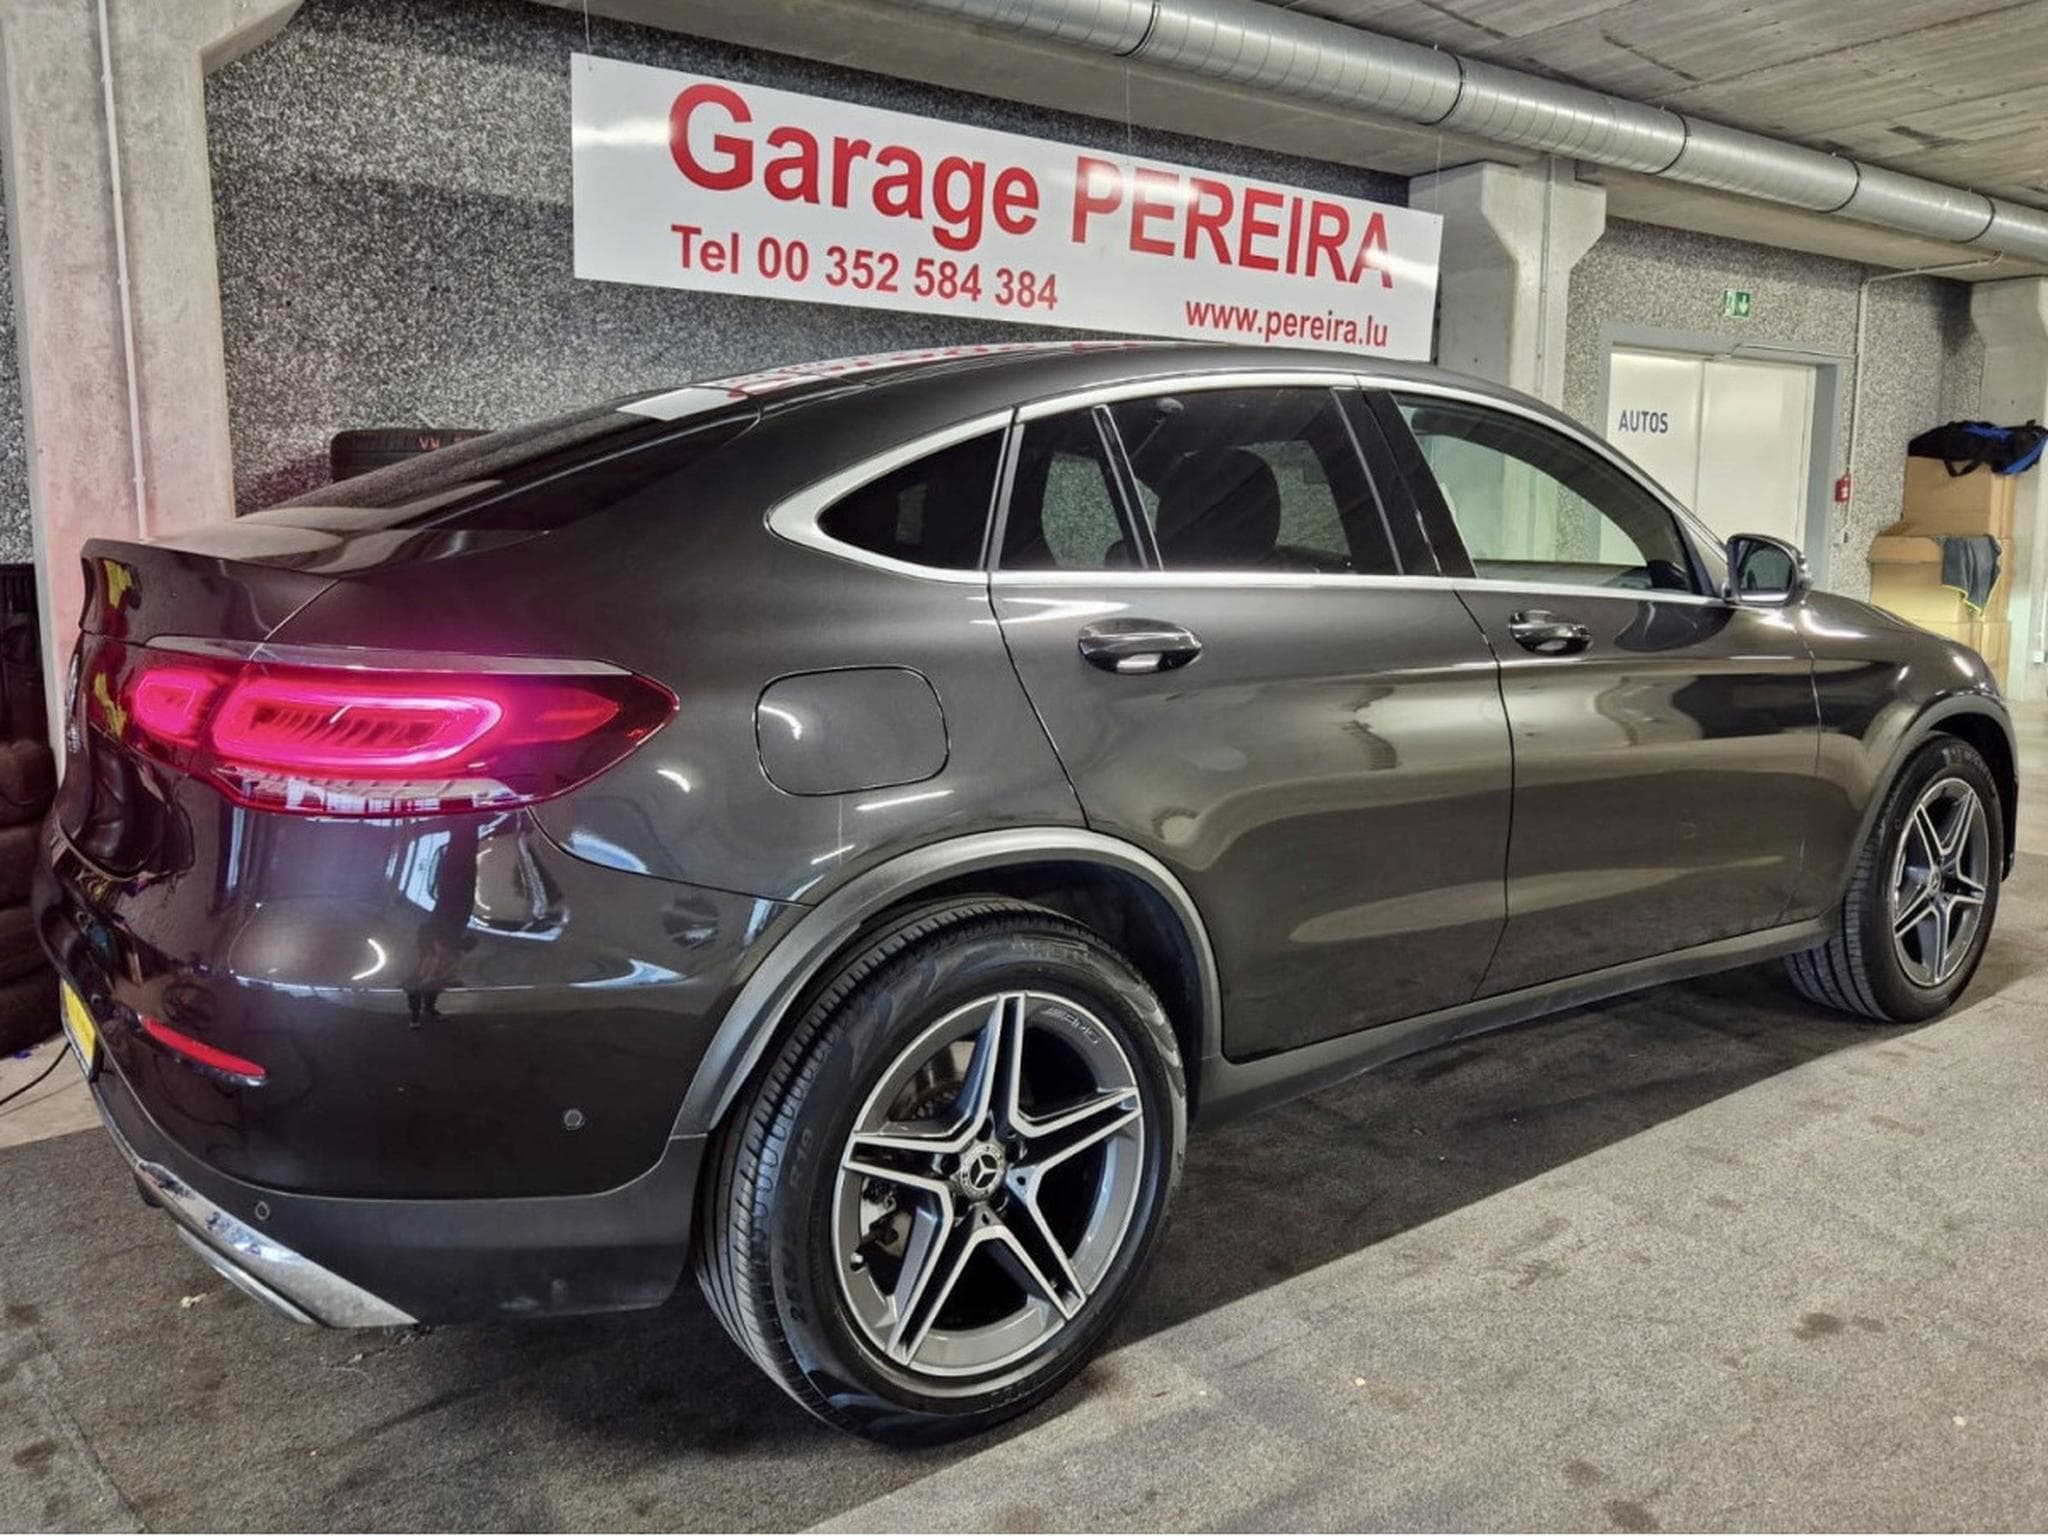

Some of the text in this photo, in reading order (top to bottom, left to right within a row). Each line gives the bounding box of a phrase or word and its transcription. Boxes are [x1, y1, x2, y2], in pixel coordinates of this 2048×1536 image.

[668, 83, 1395, 290] Garage PEREIRA
[669, 222, 1058, 311] Tel 00 352 584 384
[1184, 300, 1390, 348] www.pereira.lu
[1618, 409, 1669, 434] AUTOS
